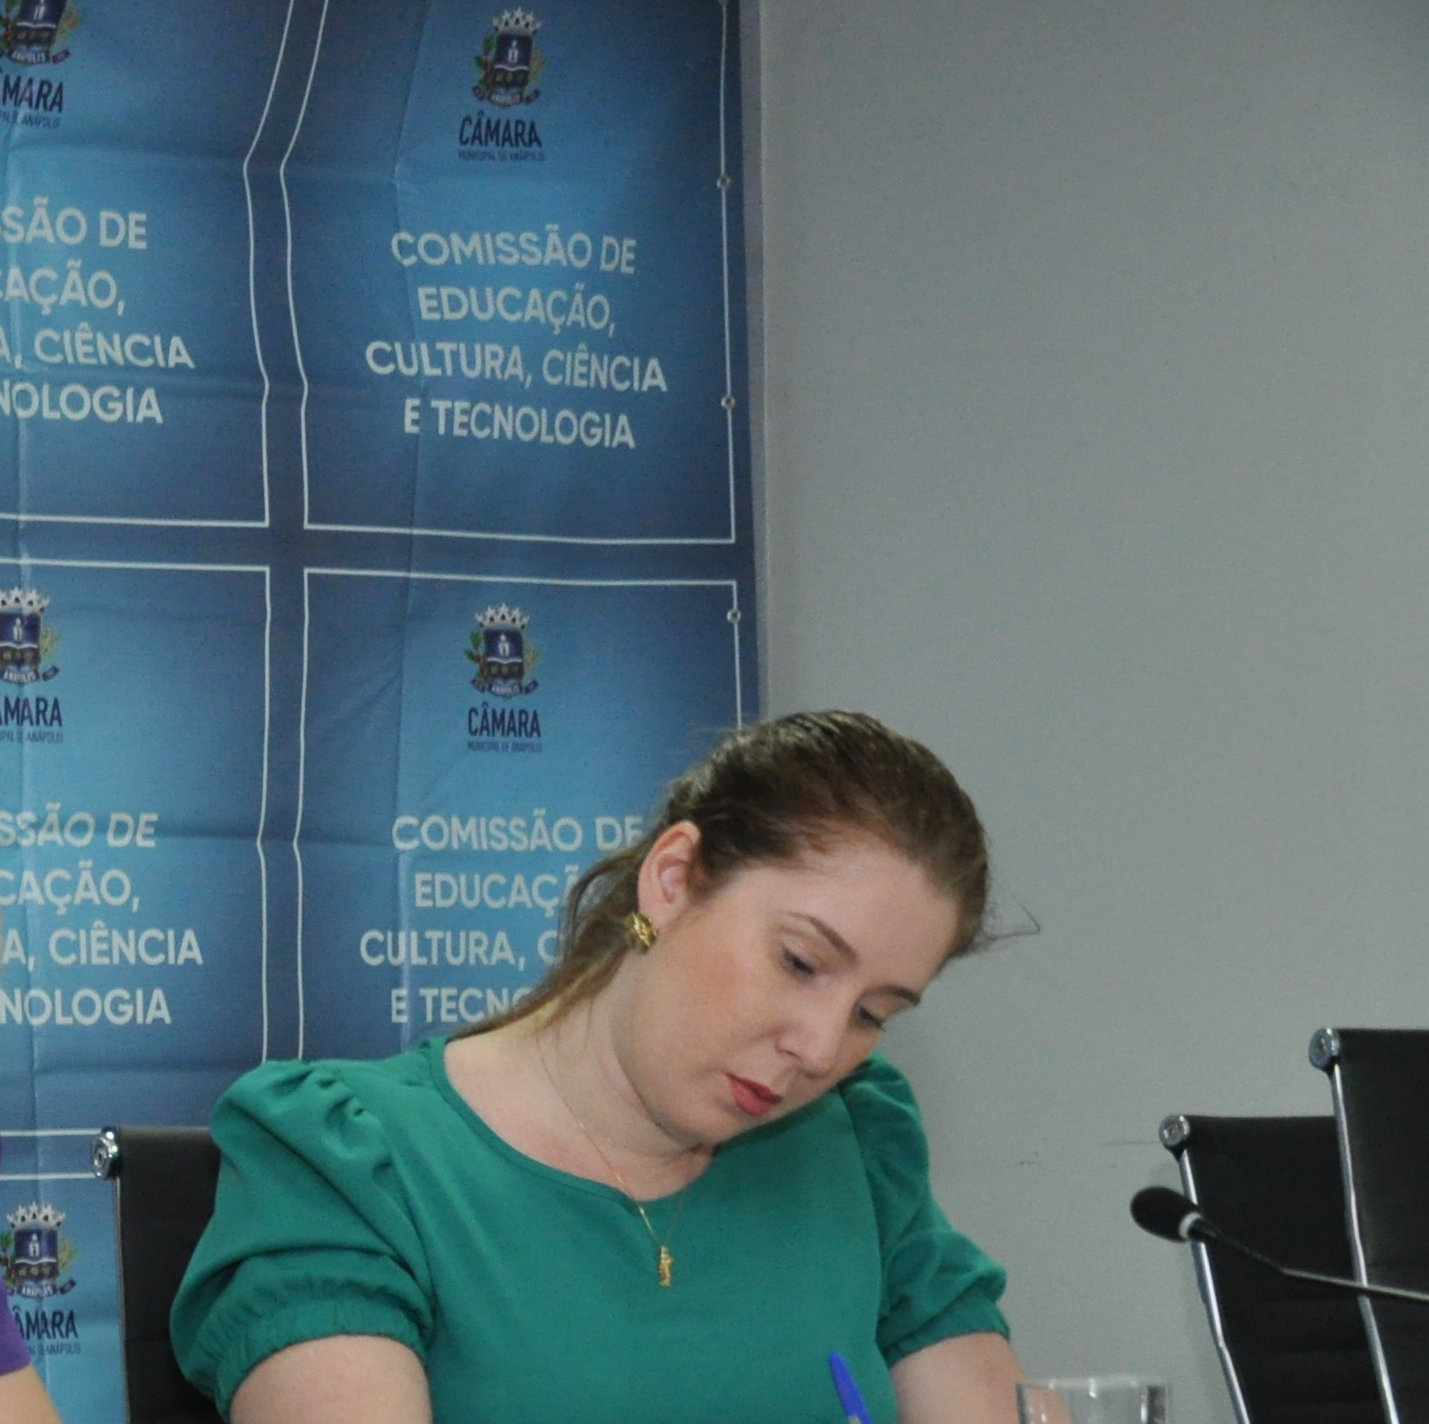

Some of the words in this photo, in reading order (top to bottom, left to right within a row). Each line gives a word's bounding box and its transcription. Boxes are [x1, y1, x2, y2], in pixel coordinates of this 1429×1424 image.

[458, 110, 543, 148] CÂMARA
[99, 209, 147, 250] DE
[391, 223, 593, 268] COMISSÃO
[599, 235, 637, 275] DE
[417, 282, 616, 339] EDUCAÇÃO,
[34, 321, 195, 369] CIÊNCIA
[365, 340, 533, 390] CULTURA,
[542, 341, 668, 393] CIÊNCIA
[404, 397, 421, 434] E
[431, 399, 636, 449] TECNOLOGIA
[468, 701, 541, 738] CÂMARA
[107, 812, 159, 848] DE
[392, 807, 584, 851] COMISSÃO
[48, 919, 203, 966] CIÊNCIA
[359, 930, 526, 971] CULTURA,
[391, 988, 408, 1024] E
